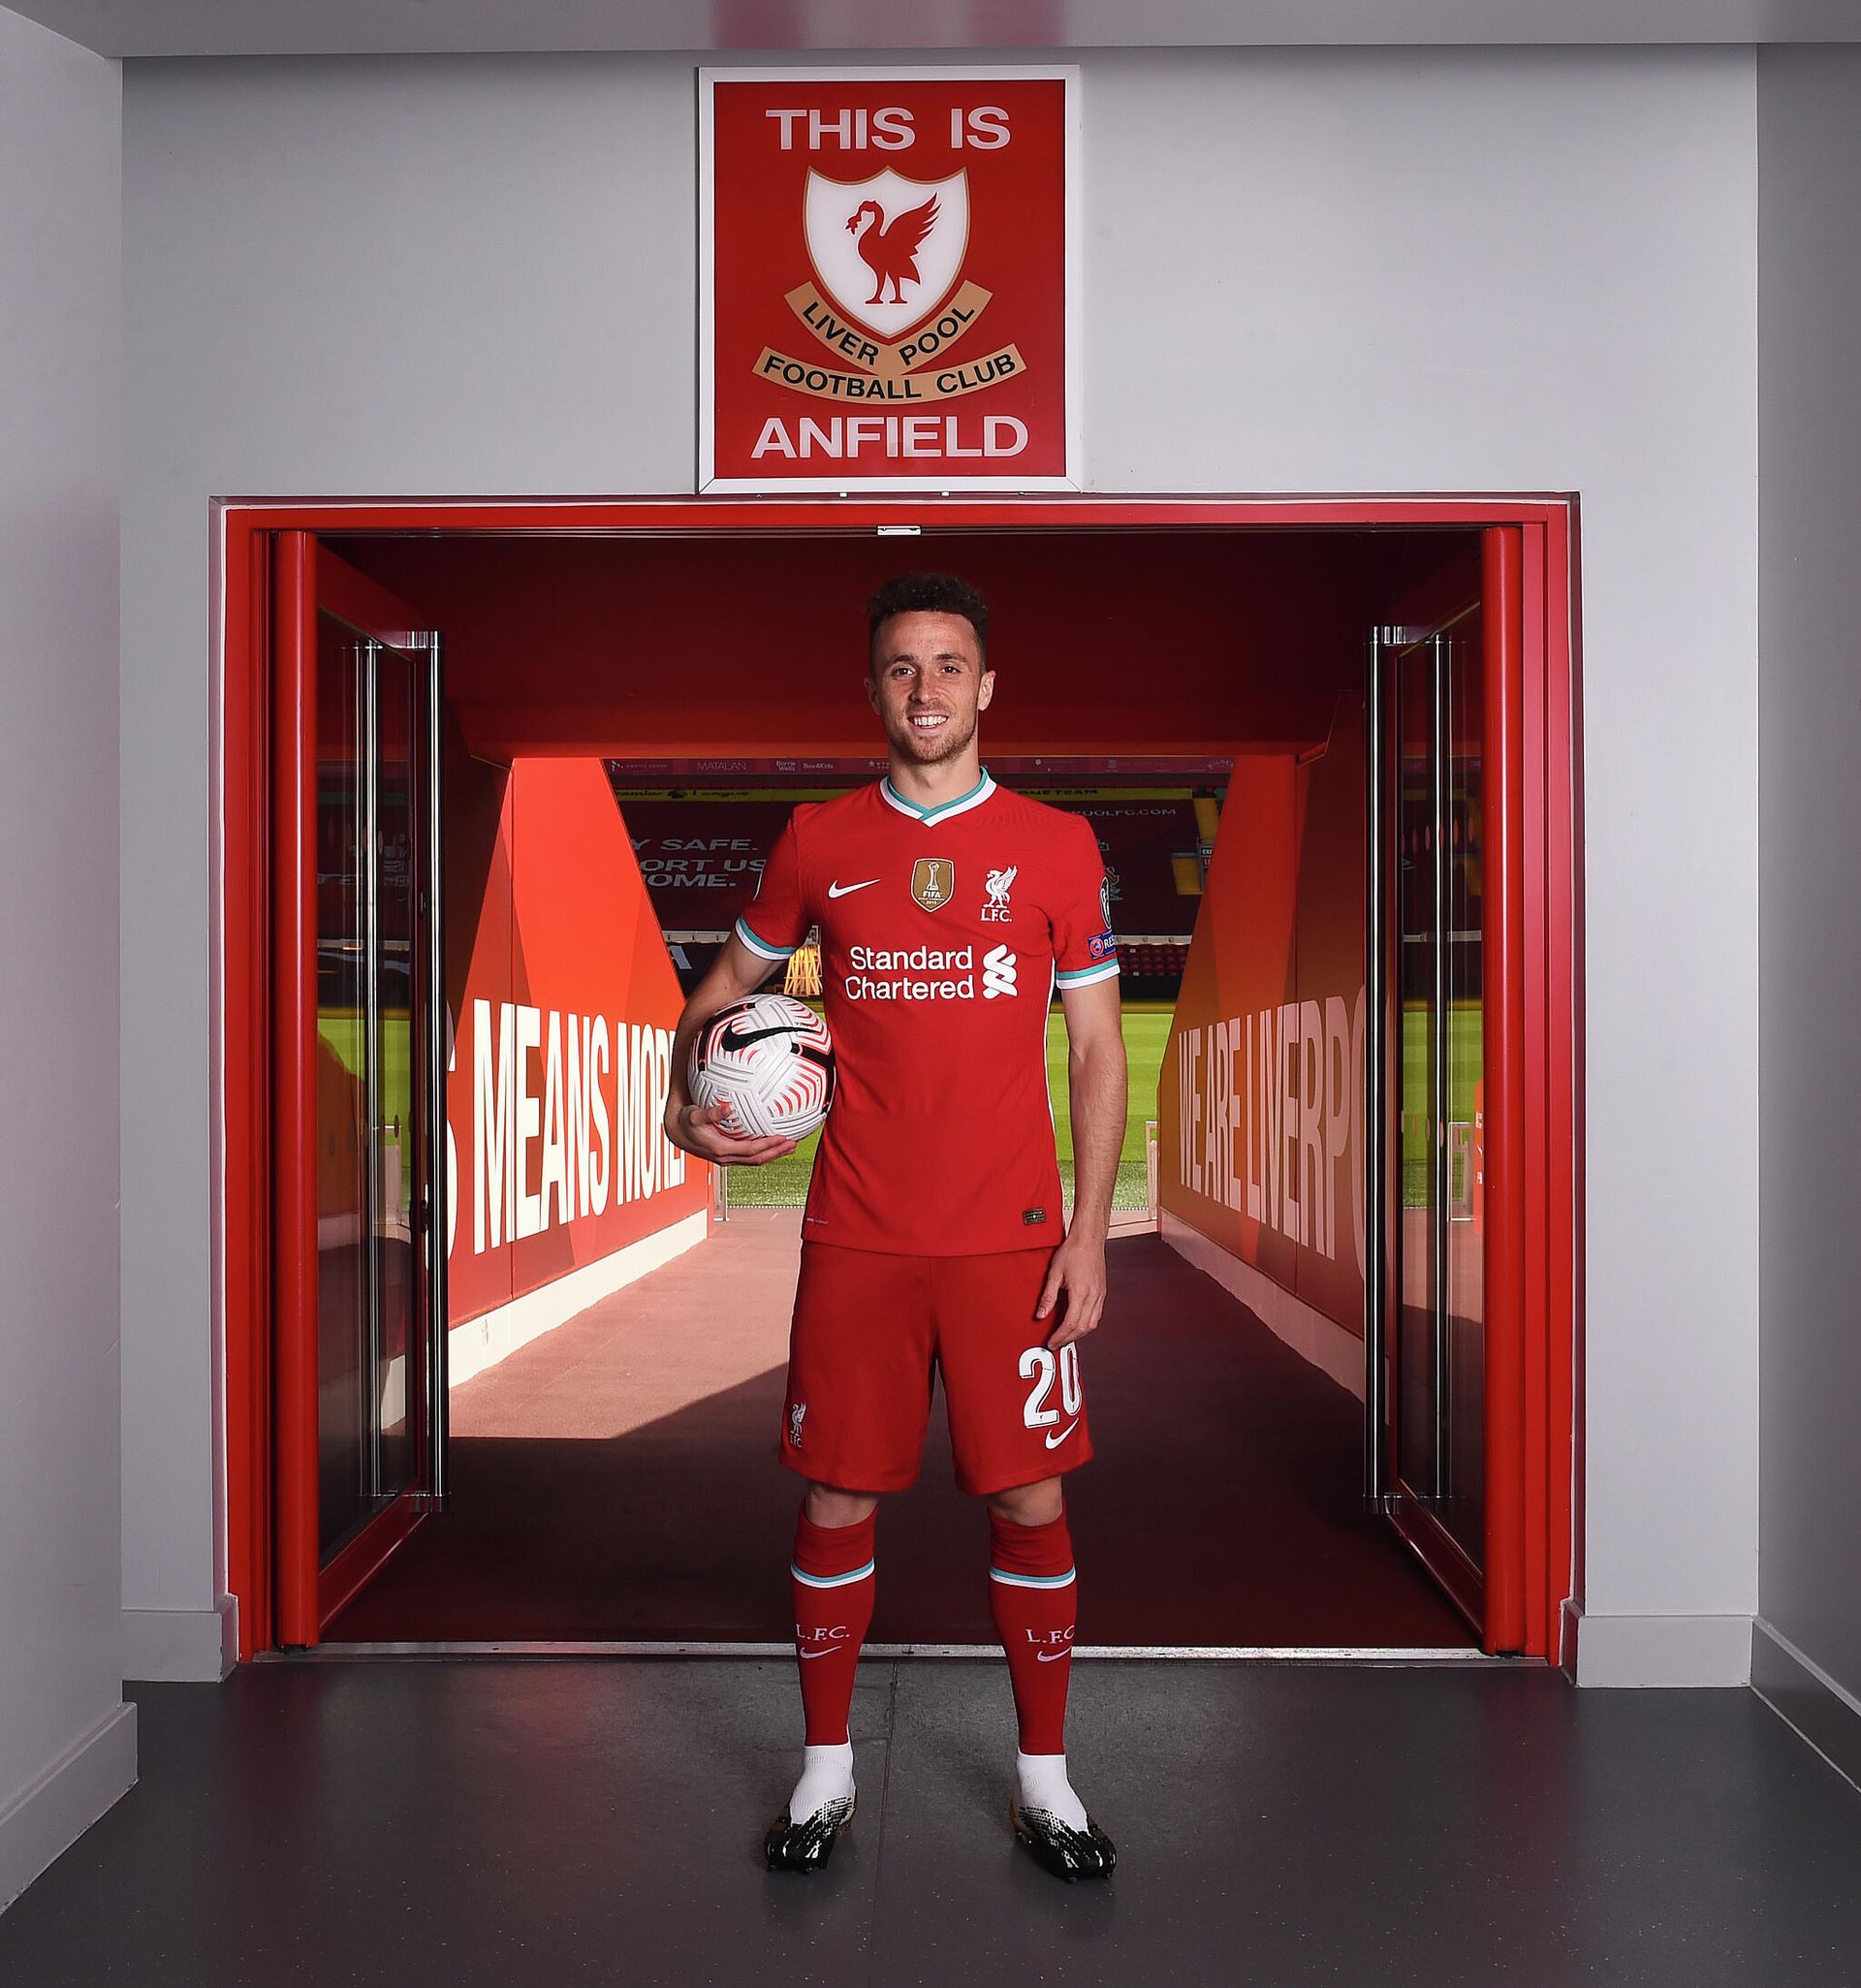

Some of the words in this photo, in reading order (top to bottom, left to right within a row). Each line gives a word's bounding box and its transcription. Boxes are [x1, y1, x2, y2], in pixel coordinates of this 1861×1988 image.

[765, 107, 916, 150] THIS
[951, 106, 1011, 150] IS
[803, 301, 879, 365] LIVER
[899, 303, 975, 366] POOL
[763, 355, 922, 399] FOOTBALL
[936, 353, 1016, 394] CLUB
[750, 415, 1029, 458] ANFIELD
[697, 761, 746, 771] MATALAN
[660, 838, 759, 851] SAFE.
[644, 873, 737, 887] OME.
[723, 859, 766, 871] US
[981, 908, 1013, 923] L.F.C.
[849, 945, 973, 971] Standard
[845, 974, 975, 1000] Chartered
[473, 997, 611, 1256] MEANS
[1178, 1027, 1202, 1194] WE
[1204, 1017, 1242, 1213] ARE
[1019, 1341, 1083, 1430] 20
